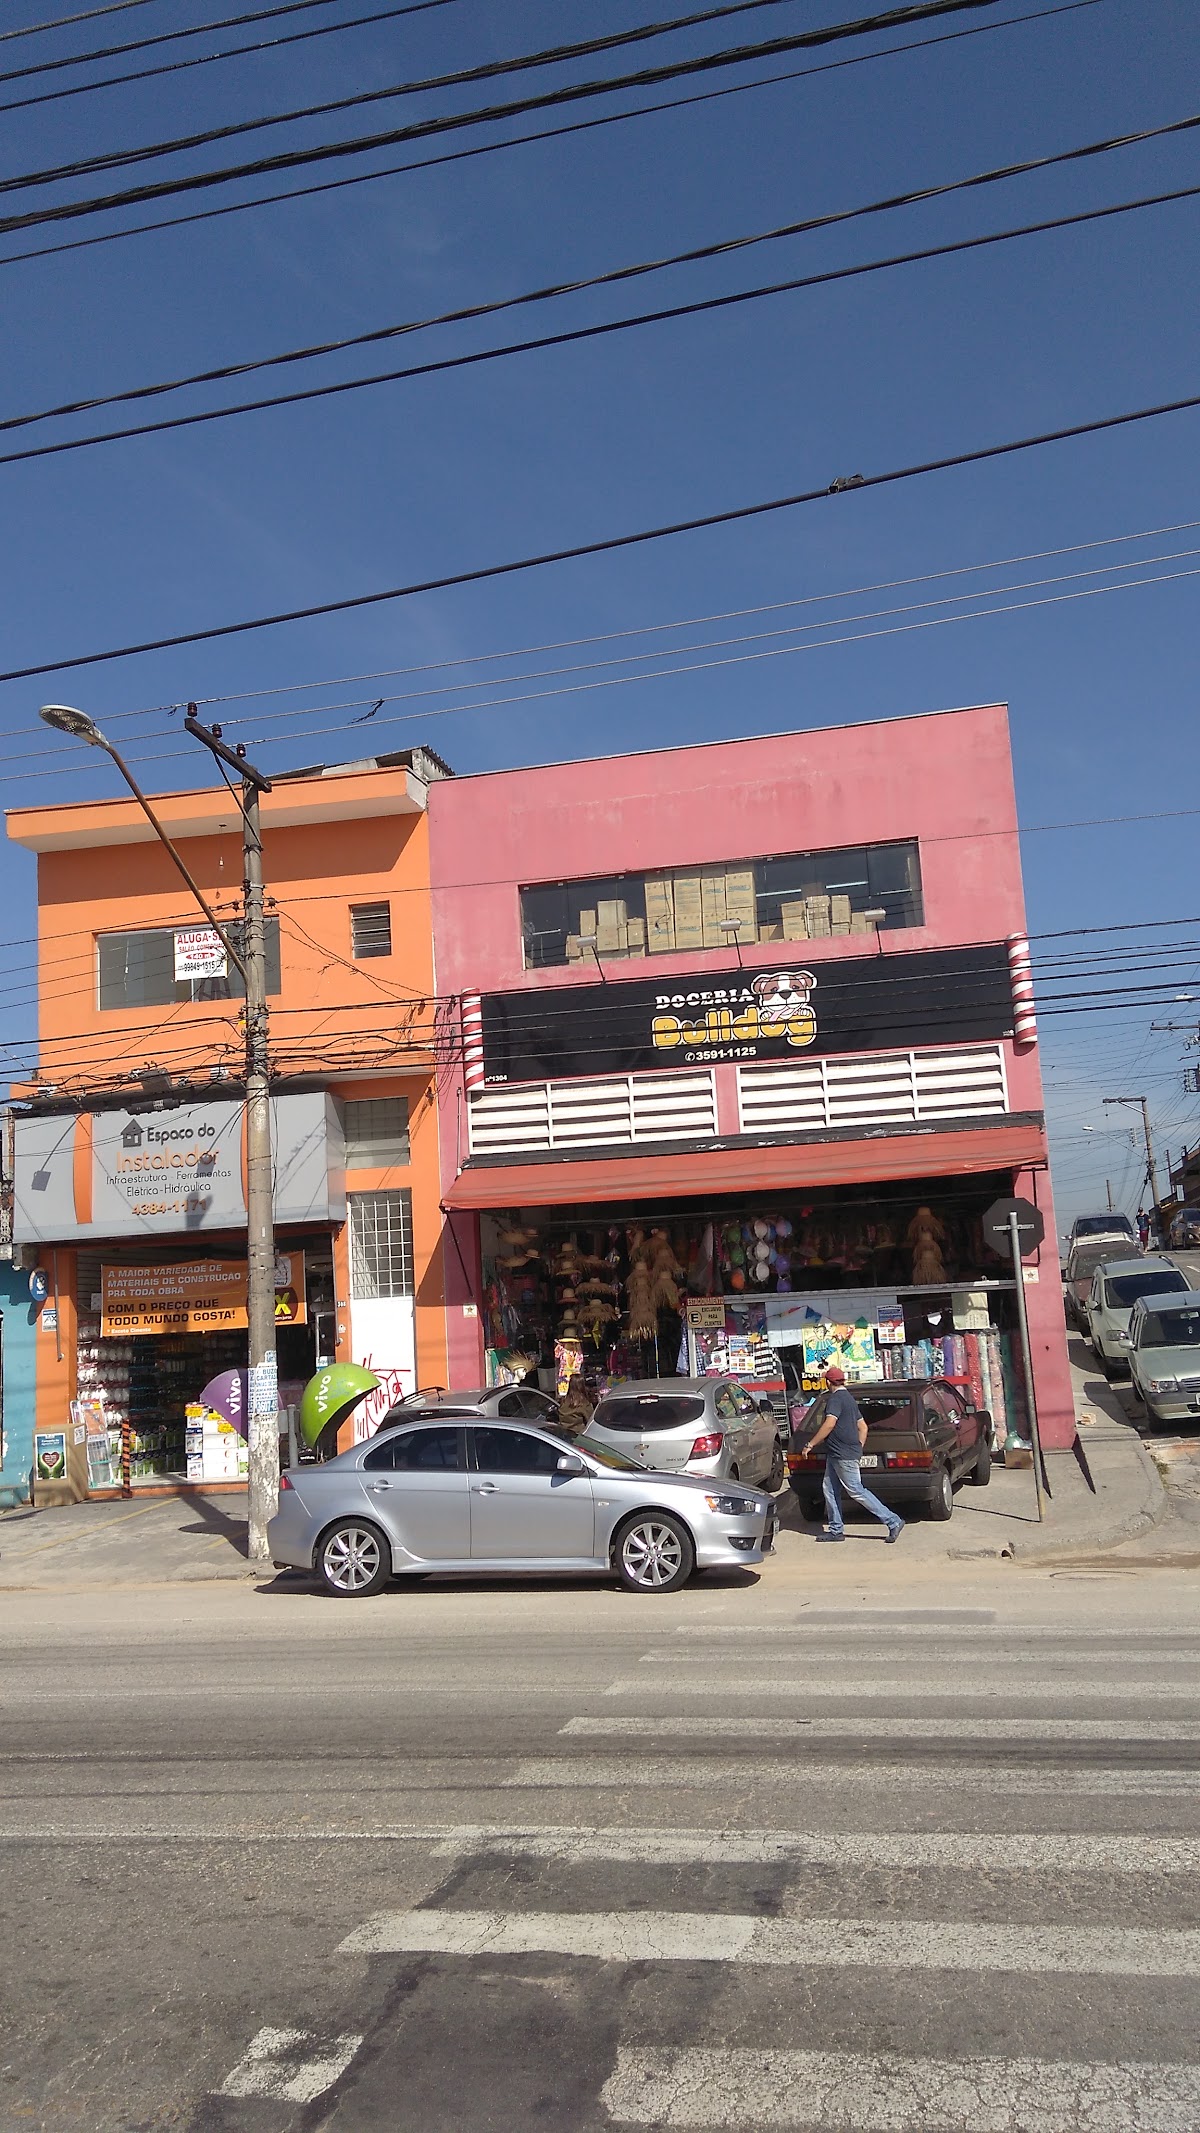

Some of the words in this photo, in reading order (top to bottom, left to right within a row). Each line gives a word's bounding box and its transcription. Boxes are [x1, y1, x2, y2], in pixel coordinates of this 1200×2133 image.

[655, 988, 755, 1010] DOCERIA
[652, 1005, 817, 1049] Bulldog
[695, 1047, 757, 1060] 3591-1125
[147, 1127, 194, 1145] Espaço
[198, 1123, 215, 1138] do
[116, 1143, 219, 1173] Instalador
[106, 1173, 168, 1185] Infraestrutura
[176, 1169, 232, 1180] Ferramentas
[132, 1199, 207, 1216] 4384-1171
[108, 1270, 115, 1278] A
[118, 1269, 150, 1278] MAIOR
[153, 1265, 207, 1276] VARIEDADE
[209, 1264, 222, 1272] DE
[107, 1278, 160, 1288] MATERIAIS
[162, 1277, 175, 1285] DE
[177, 1271, 241, 1285] CONSTRUÇÃO
[107, 1289, 127, 1297] PRA
[129, 1288, 155, 1296] TODA
[158, 1286, 185, 1295] OBRA
[107, 1304, 135, 1313] COM
[138, 1303, 147, 1312] O
[150, 1300, 191, 1314] PREÇO
[194, 1299, 219, 1309] QUE
[687, 1296, 724, 1305] ESTACIONAMENTO
[107, 1316, 139, 1326] TODO
[143, 1314, 189, 1325] MUNDO
[193, 1310, 236, 1321] GOSTA!
[691, 1313, 699, 1323] E
[225, 1377, 242, 1415] vivo
[314, 1375, 332, 1413] vivo
